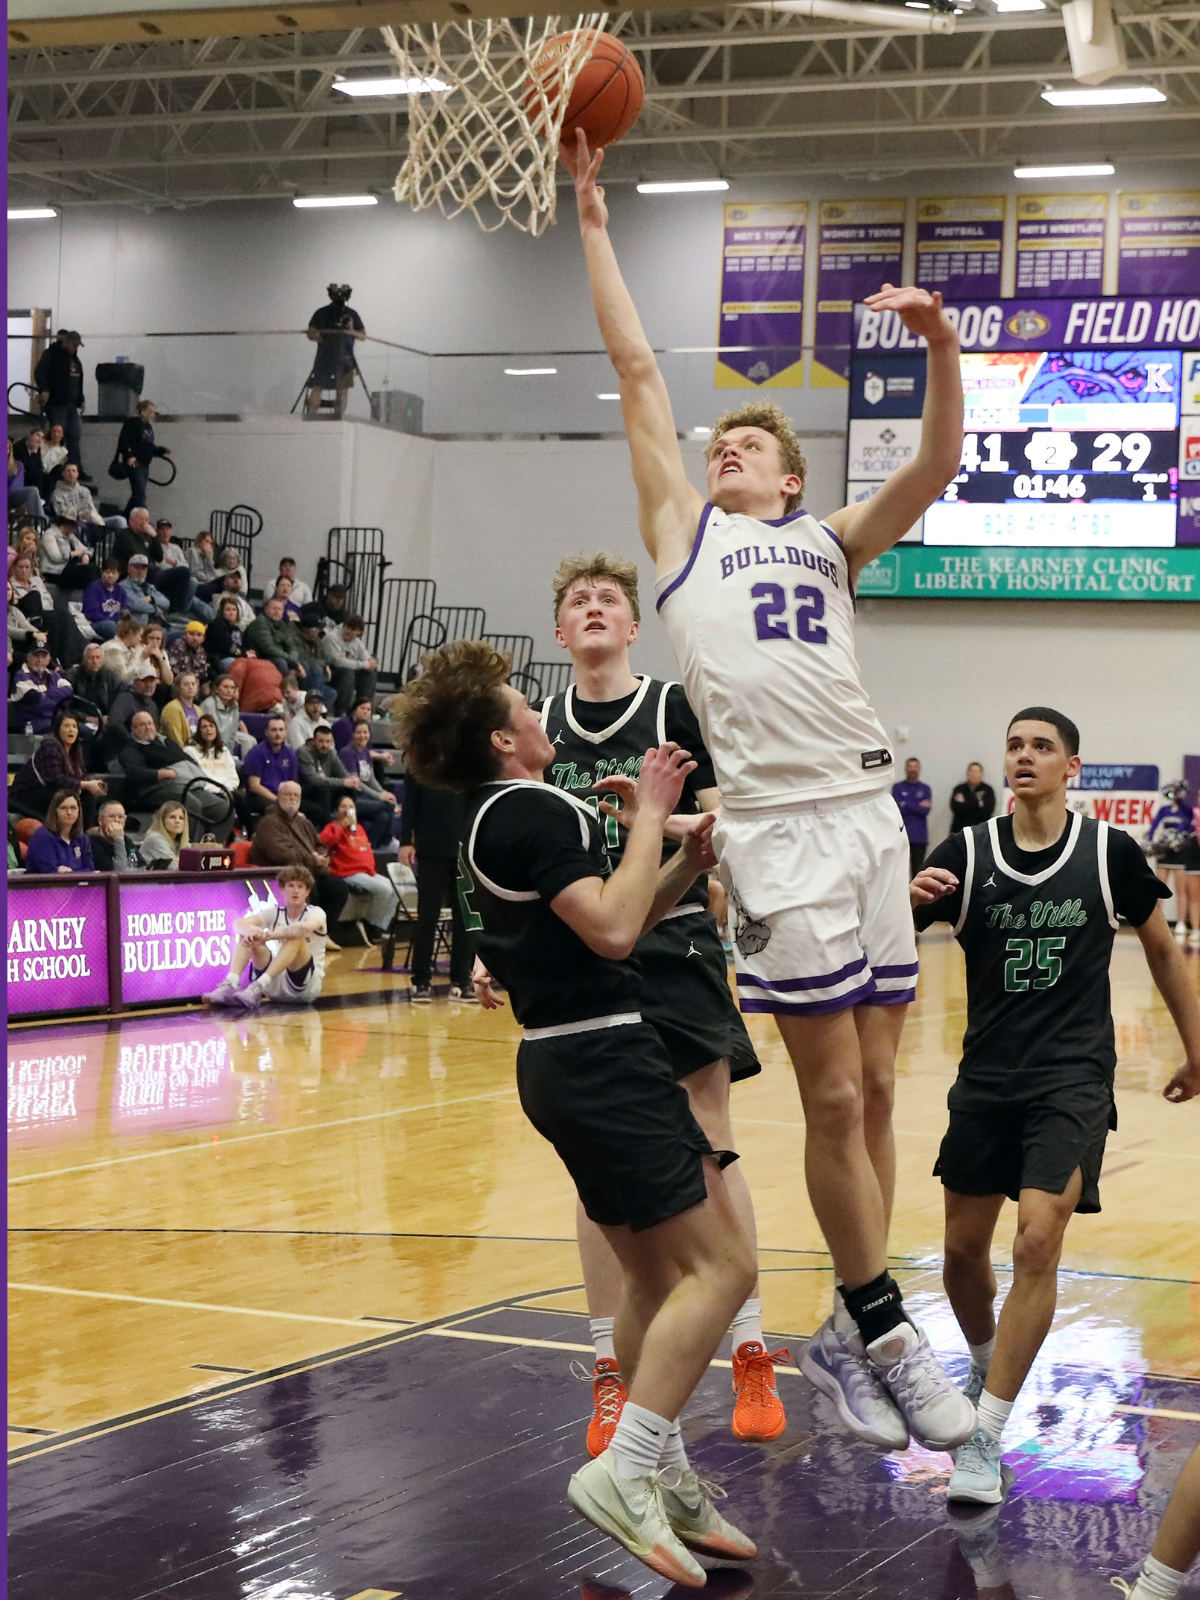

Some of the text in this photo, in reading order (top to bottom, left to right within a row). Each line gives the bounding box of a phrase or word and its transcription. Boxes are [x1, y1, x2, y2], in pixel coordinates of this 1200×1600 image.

[1063, 300, 1153, 344] FIELD
[1144, 363, 1173, 392] K
[1044, 446, 1057, 465] 2
[1092, 432, 1151, 472] 29
[944, 483, 958, 501] 2
[1013, 474, 1086, 498] 01:46
[1143, 483, 1157, 501] 1
[720, 545, 839, 589] BULLDOGS
[940, 556, 1169, 576] THE KEARNEY CLINIC
[914, 573, 1195, 592] LIBERTY HOSPITAL COURT
[749, 581, 829, 646] 22
[552, 755, 645, 791] The Vill
[1081, 777, 1116, 789] LAW
[1093, 799, 1155, 825] WEEK
[127, 909, 226, 937] HOME OF THE
[985, 898, 1088, 930] The Ville
[8, 916, 87, 953] ARNEY
[23, 954, 91, 982] SCHOOL
[123, 935, 231, 973] BULLDOGS
[1004, 936, 1066, 992] 25
